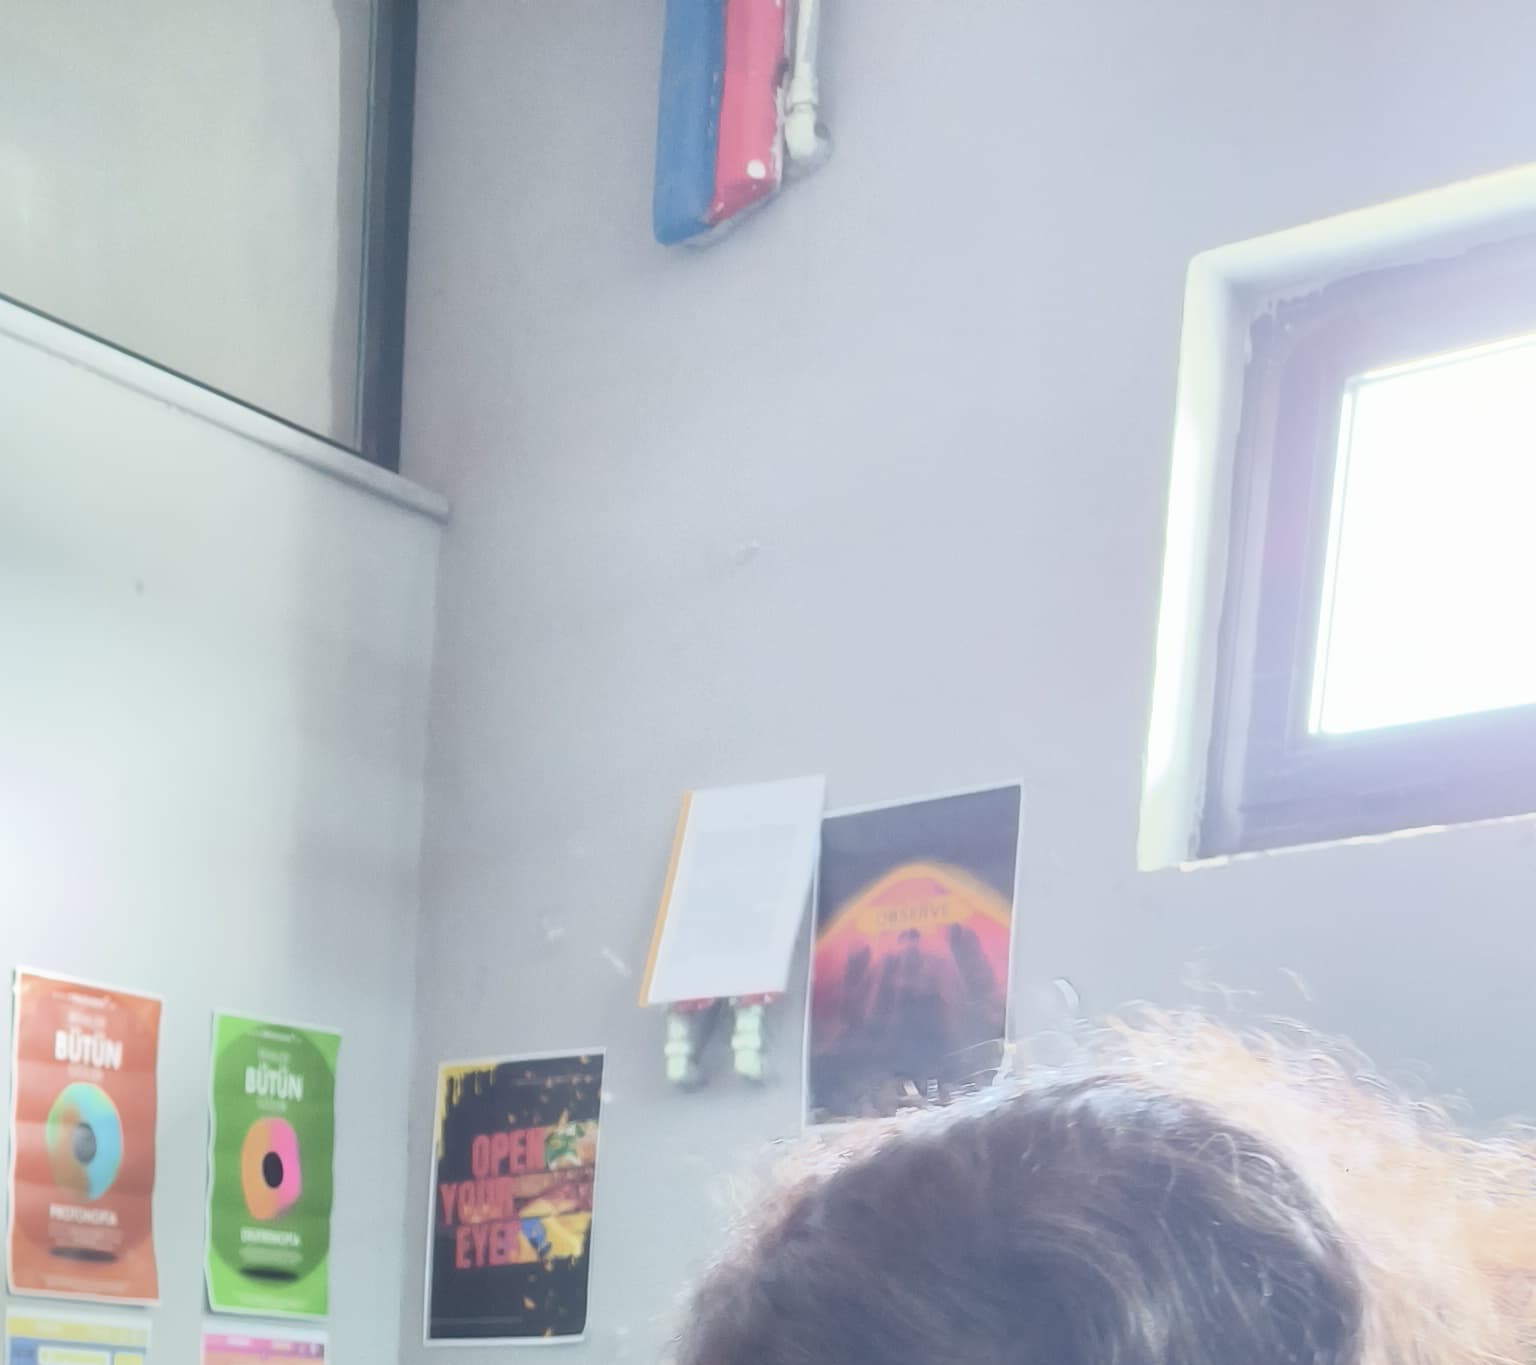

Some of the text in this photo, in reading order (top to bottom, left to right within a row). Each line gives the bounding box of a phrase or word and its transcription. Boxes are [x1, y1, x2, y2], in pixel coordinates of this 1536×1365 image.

[54, 1026, 124, 1071] BÜTÜN
[244, 1060, 304, 1103] BÜTÜN
[471, 1126, 547, 1180] OPEN
[439, 1176, 514, 1226] YOUR
